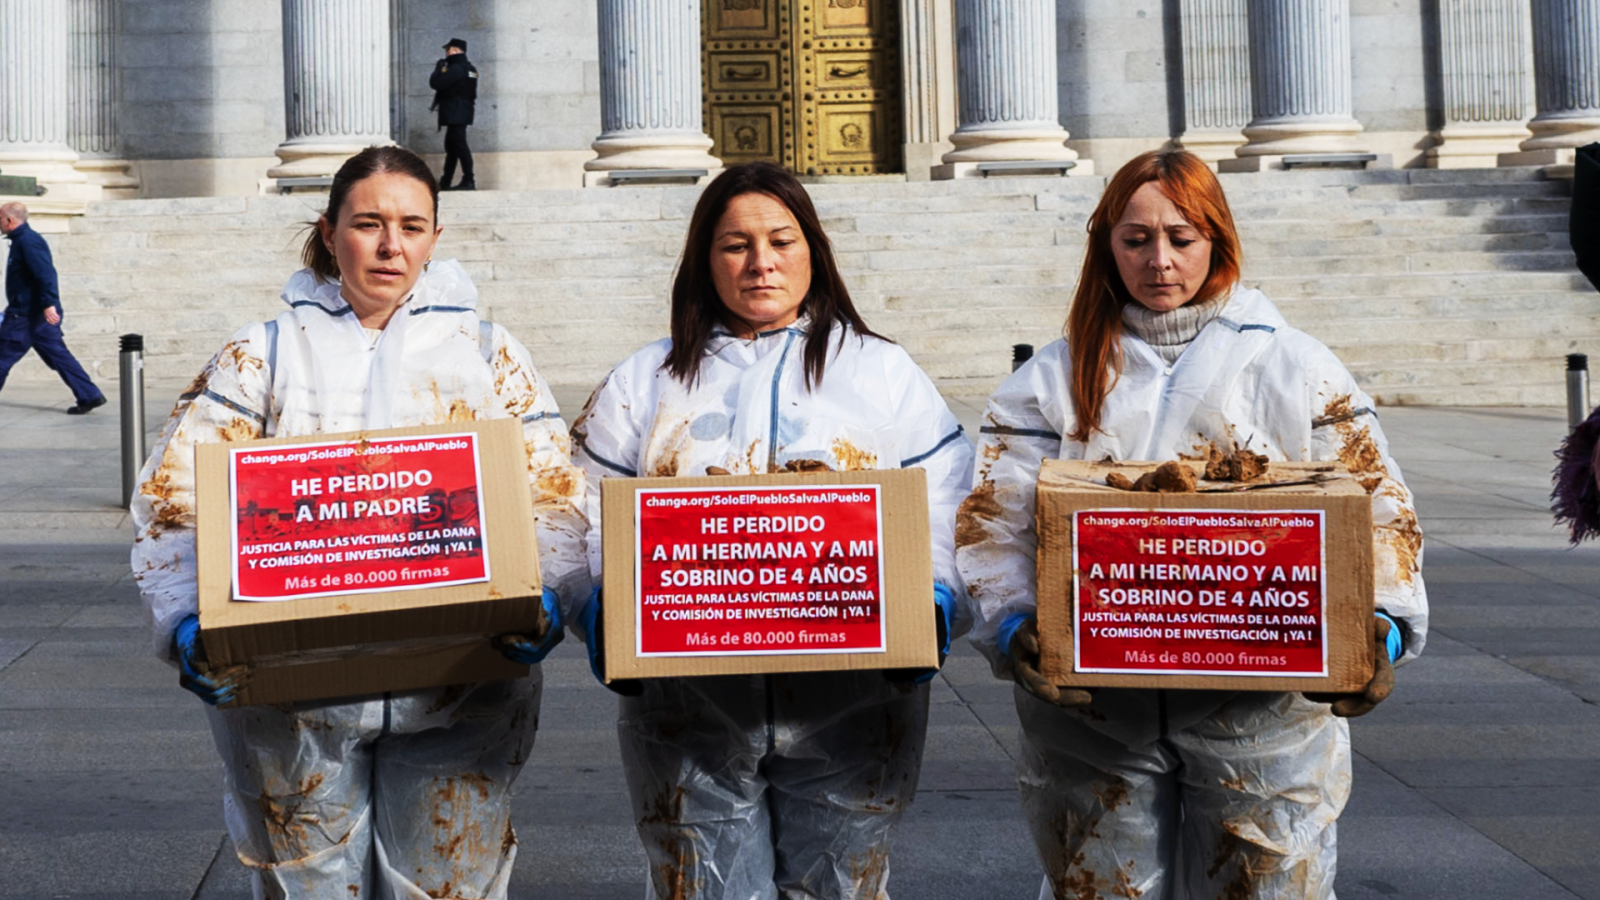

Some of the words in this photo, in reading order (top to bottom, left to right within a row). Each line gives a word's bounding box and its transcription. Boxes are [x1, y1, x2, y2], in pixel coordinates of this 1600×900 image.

[292, 478, 322, 496] HE
[329, 469, 432, 494] PERDIDO
[296, 506, 313, 522] A
[320, 504, 347, 520] MI
[354, 496, 430, 518] PADRE
[646, 492, 870, 508] change.org/SoloElPuebloSalvaAlPueblo
[701, 518, 728, 534] HE
[733, 515, 825, 533] PERDIDO
[1084, 516, 1314, 528] change.org/SoloElPuebloSalvaAlPueblo
[240, 542, 292, 555] JUSTICIA
[294, 539, 325, 551] PARA
[327, 537, 349, 548] LAS
[350, 532, 406, 545] VÍCTIMAS
[409, 531, 423, 542] DE
[426, 530, 440, 540] LA
[443, 527, 476, 538] DANA
[1140, 539, 1166, 554] HE
[1172, 539, 1266, 556] PERDIDO
[248, 559, 257, 569] Y
[260, 553, 323, 569] COMISIÓN
[326, 552, 343, 563] DE
[345, 543, 439, 561] INVESTIGACIÓN
[653, 545, 667, 561] A
[672, 545, 697, 560] MI
[703, 541, 807, 560] HERMANA
[811, 541, 824, 557] Y
[829, 541, 844, 557] A
[850, 540, 873, 557] MI
[285, 575, 316, 590] Más
[321, 574, 340, 587] de
[344, 571, 397, 585] 80.000
[401, 566, 449, 579] firmas
[660, 569, 754, 587] SOBRINO
[760, 568, 786, 585] DE
[791, 568, 804, 584] 4
[809, 563, 867, 583] AÑOS
[1090, 564, 1104, 579] A
[1110, 564, 1134, 580] MI
[1141, 564, 1248, 581] HERMANO
[1253, 566, 1265, 581] Y
[1271, 566, 1286, 581] A
[1292, 566, 1317, 582] MI
[644, 594, 694, 605] JUSTICIA
[696, 594, 725, 604] PARA
[728, 593, 749, 603] LAS
[751, 591, 804, 603] VÍCTIMAS
[807, 592, 822, 601] DE
[825, 591, 839, 601] LA
[842, 591, 874, 601] DANA
[1099, 589, 1193, 606] SOBRINO
[1199, 591, 1226, 606] DE
[1231, 591, 1244, 606] 4
[1249, 588, 1309, 607] AÑOS
[652, 611, 660, 620] Y
[663, 607, 724, 620] COMISIÓN
[726, 609, 742, 619] DE
[745, 605, 837, 619] INVESTIGACIÓN
[1082, 612, 1131, 622] JUSTICIA
[1134, 613, 1164, 623] PARA
[1167, 613, 1188, 623] LAS
[1190, 612, 1245, 624] VÍCTIMAS
[1247, 614, 1263, 624] DE
[1265, 615, 1280, 624] LA
[1283, 615, 1316, 625] DANA
[686, 633, 716, 645] Más
[721, 632, 739, 644] de
[743, 632, 795, 644] 80.000
[798, 630, 846, 643] firmas
[1090, 628, 1098, 638] Y
[1100, 626, 1162, 638] COMISIÓN
[1165, 628, 1181, 639] DE
[1184, 628, 1278, 640] INVESTIGACIÓN
[1125, 650, 1155, 663] Más
[1159, 651, 1178, 663] de
[1182, 652, 1235, 665] 80.000
[1238, 652, 1286, 665] firmas
